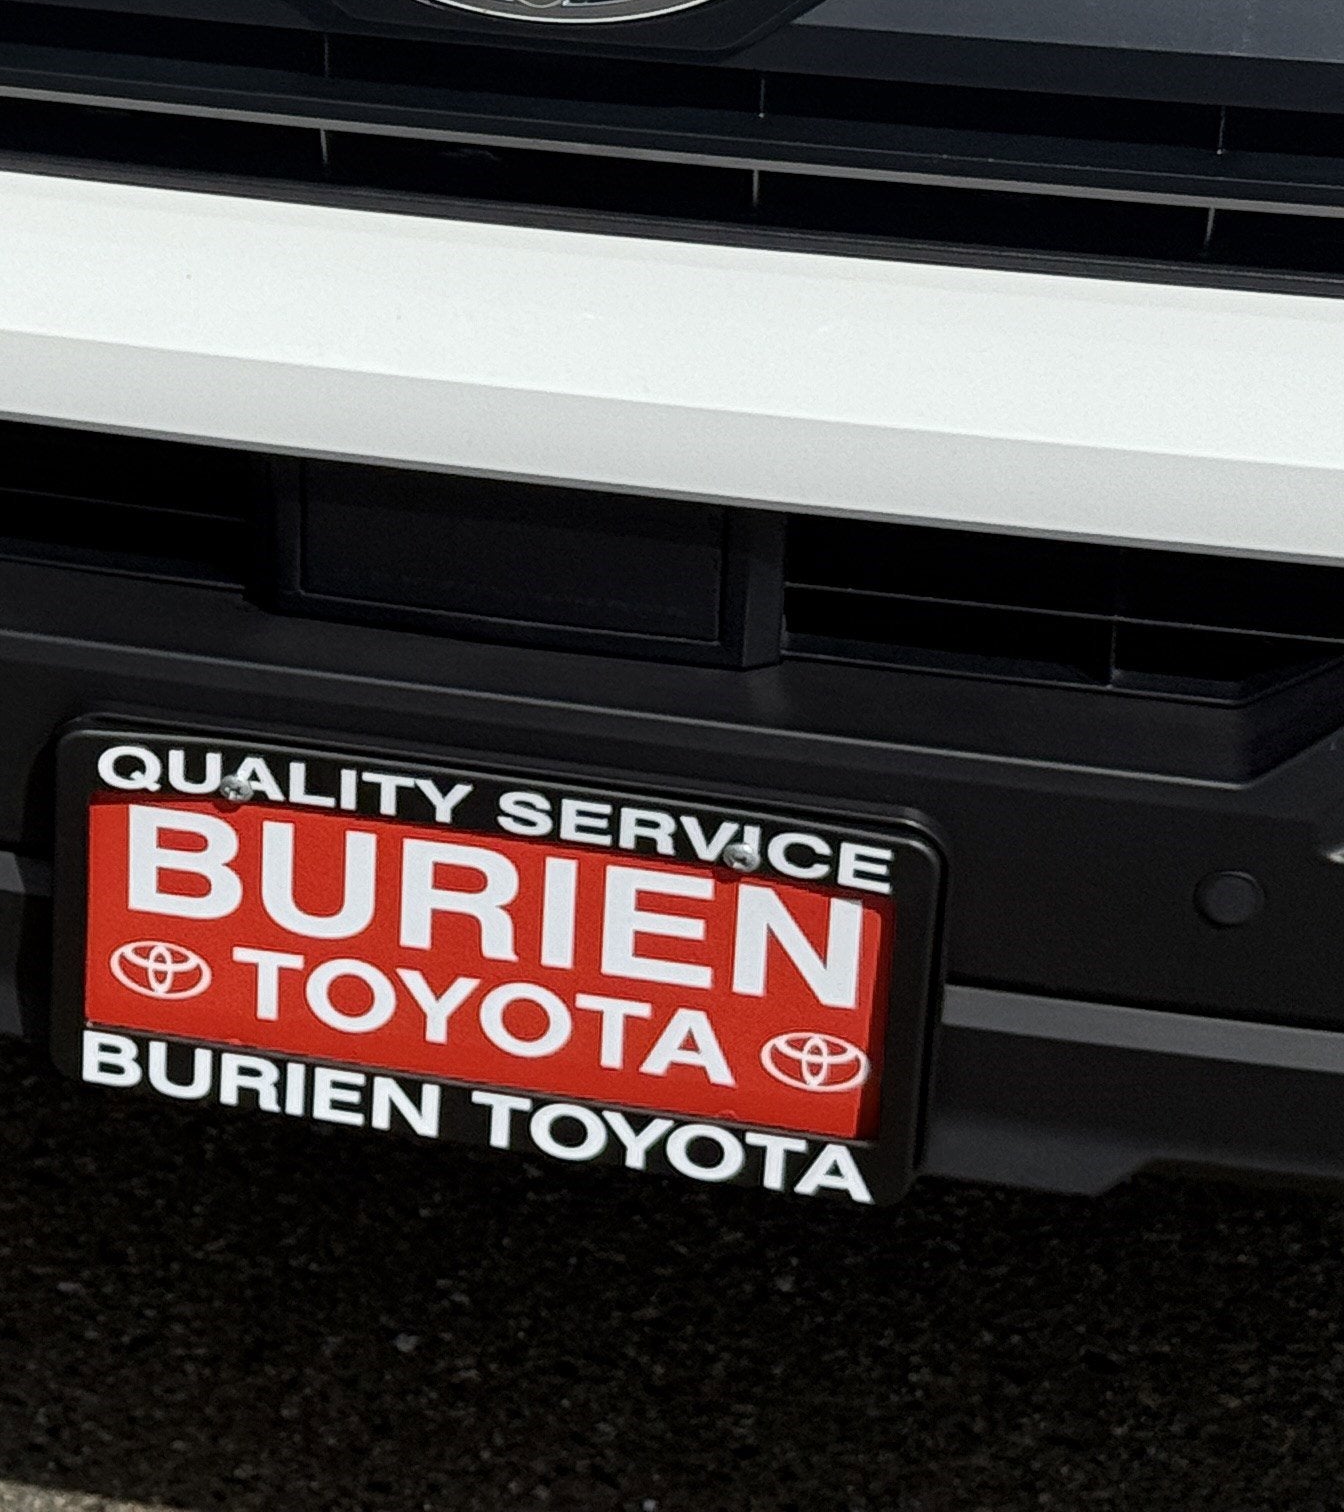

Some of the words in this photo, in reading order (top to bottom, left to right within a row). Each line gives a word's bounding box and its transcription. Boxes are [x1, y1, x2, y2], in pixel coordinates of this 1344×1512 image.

[97, 745, 472, 823] QUALITY
[497, 791, 894, 895] SERVICE
[127, 804, 863, 1010] BURIEN
[232, 946, 734, 1087] TOYOTA
[81, 1029, 440, 1139] BURIEN
[472, 1091, 873, 1205] TOYOTA
